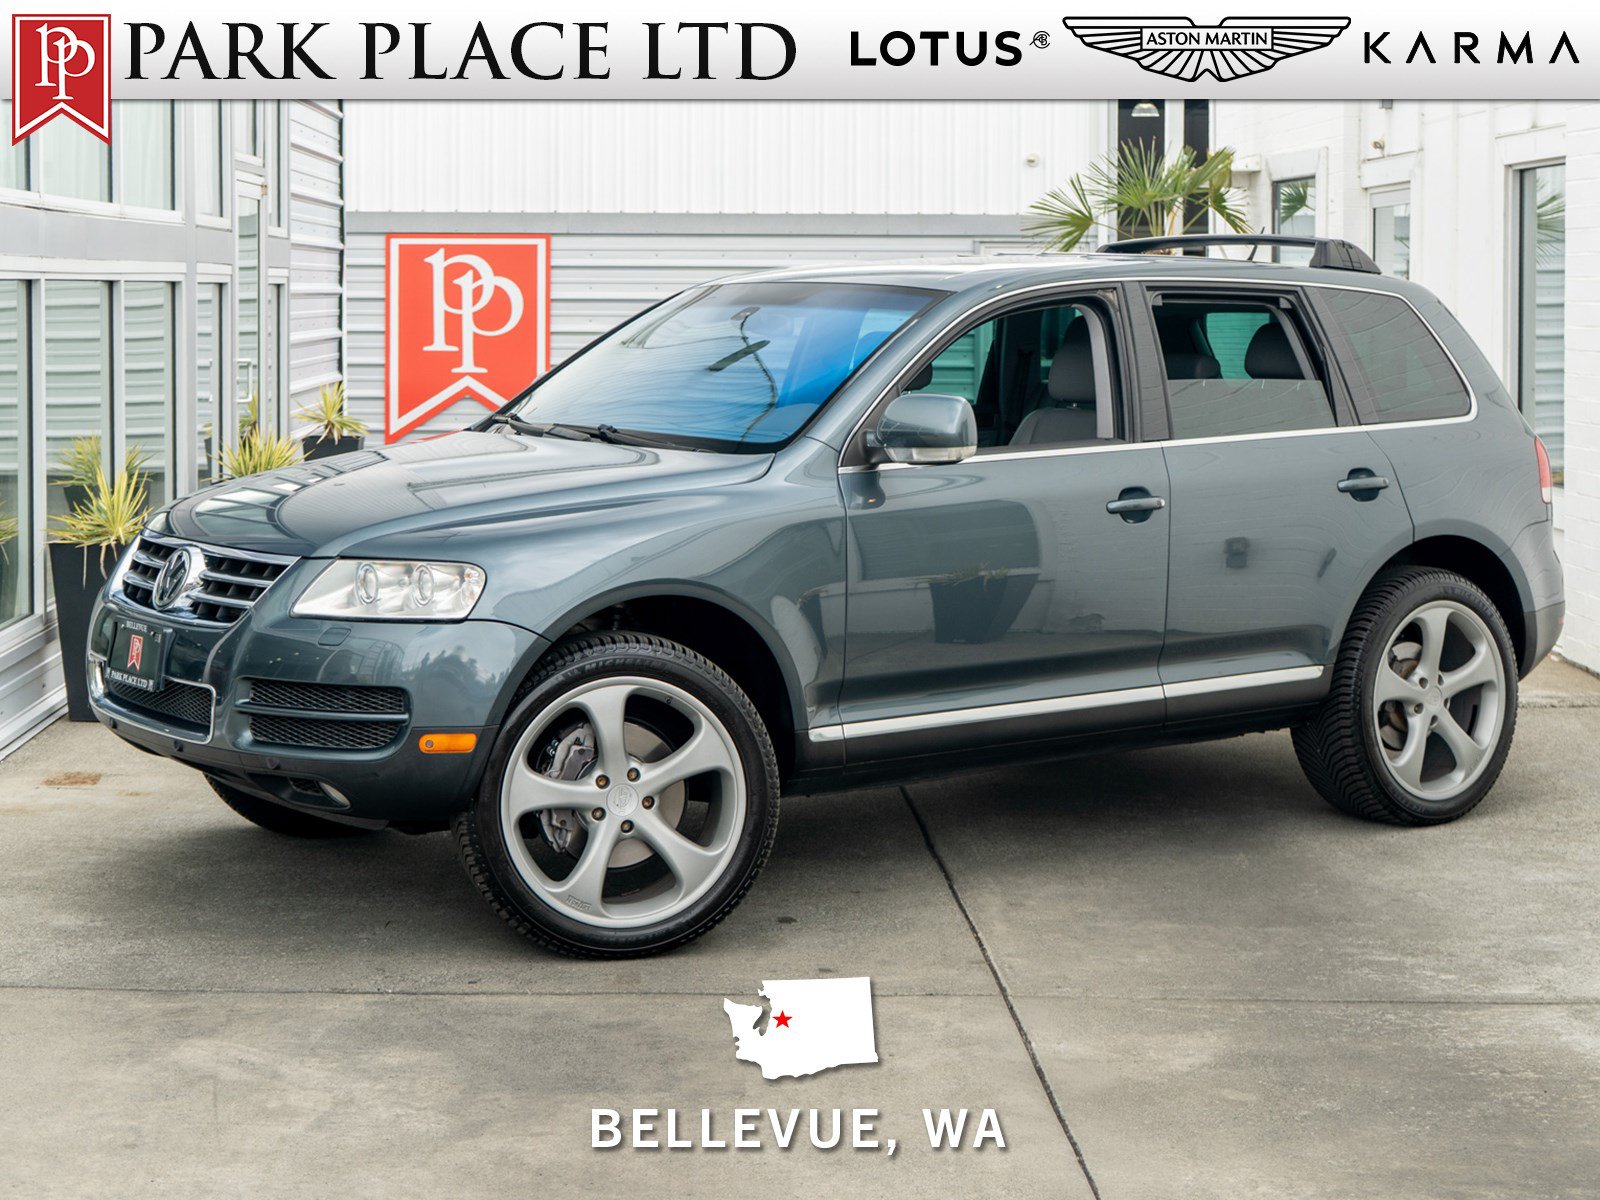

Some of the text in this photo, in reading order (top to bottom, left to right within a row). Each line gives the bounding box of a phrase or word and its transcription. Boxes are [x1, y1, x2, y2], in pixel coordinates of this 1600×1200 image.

[111, 670, 148, 688] PARK PLACE LTD
